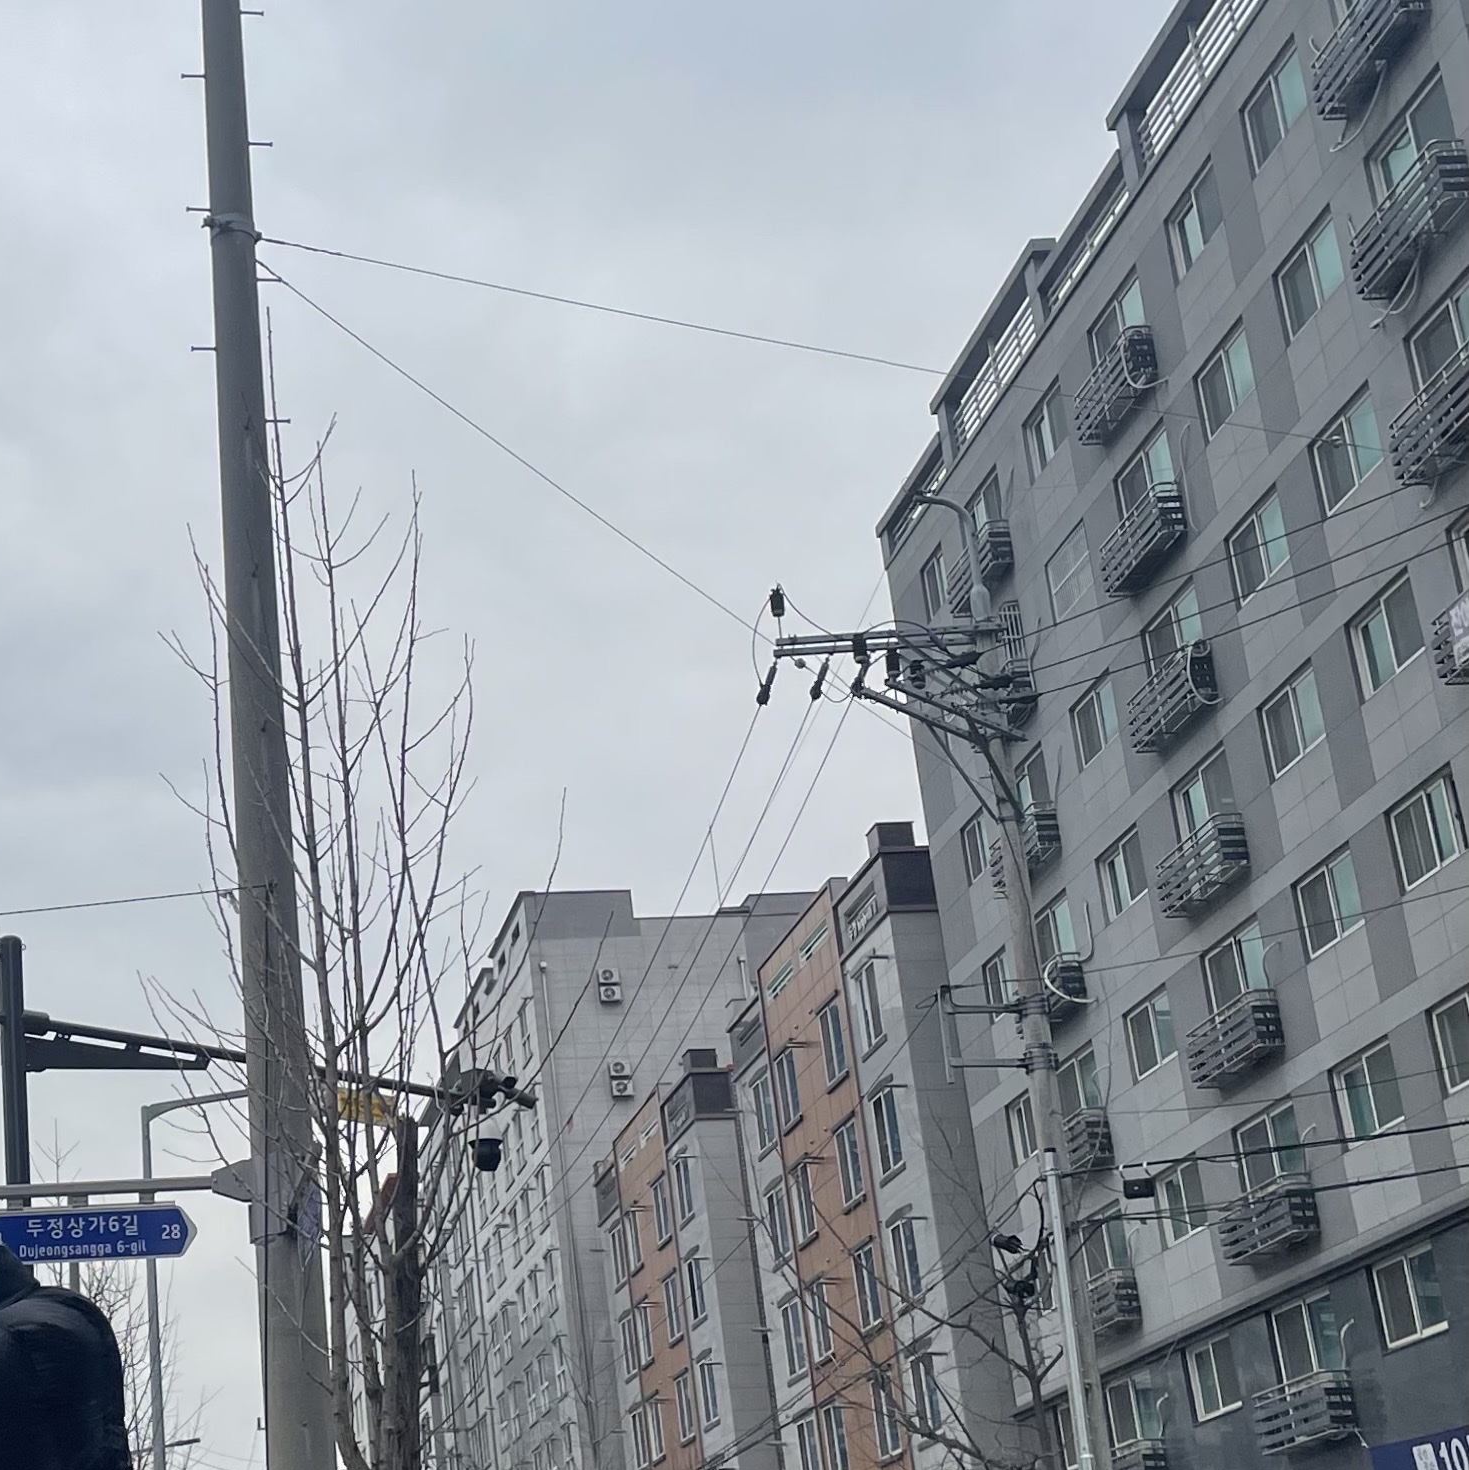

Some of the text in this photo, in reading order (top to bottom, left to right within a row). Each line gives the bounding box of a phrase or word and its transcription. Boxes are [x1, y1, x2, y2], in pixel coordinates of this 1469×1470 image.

[26, 1215, 138, 1239] 두정상가6길
[161, 1225, 180, 1240] 28
[19, 1240, 147, 1258] Dujeongsangga 6-gil
